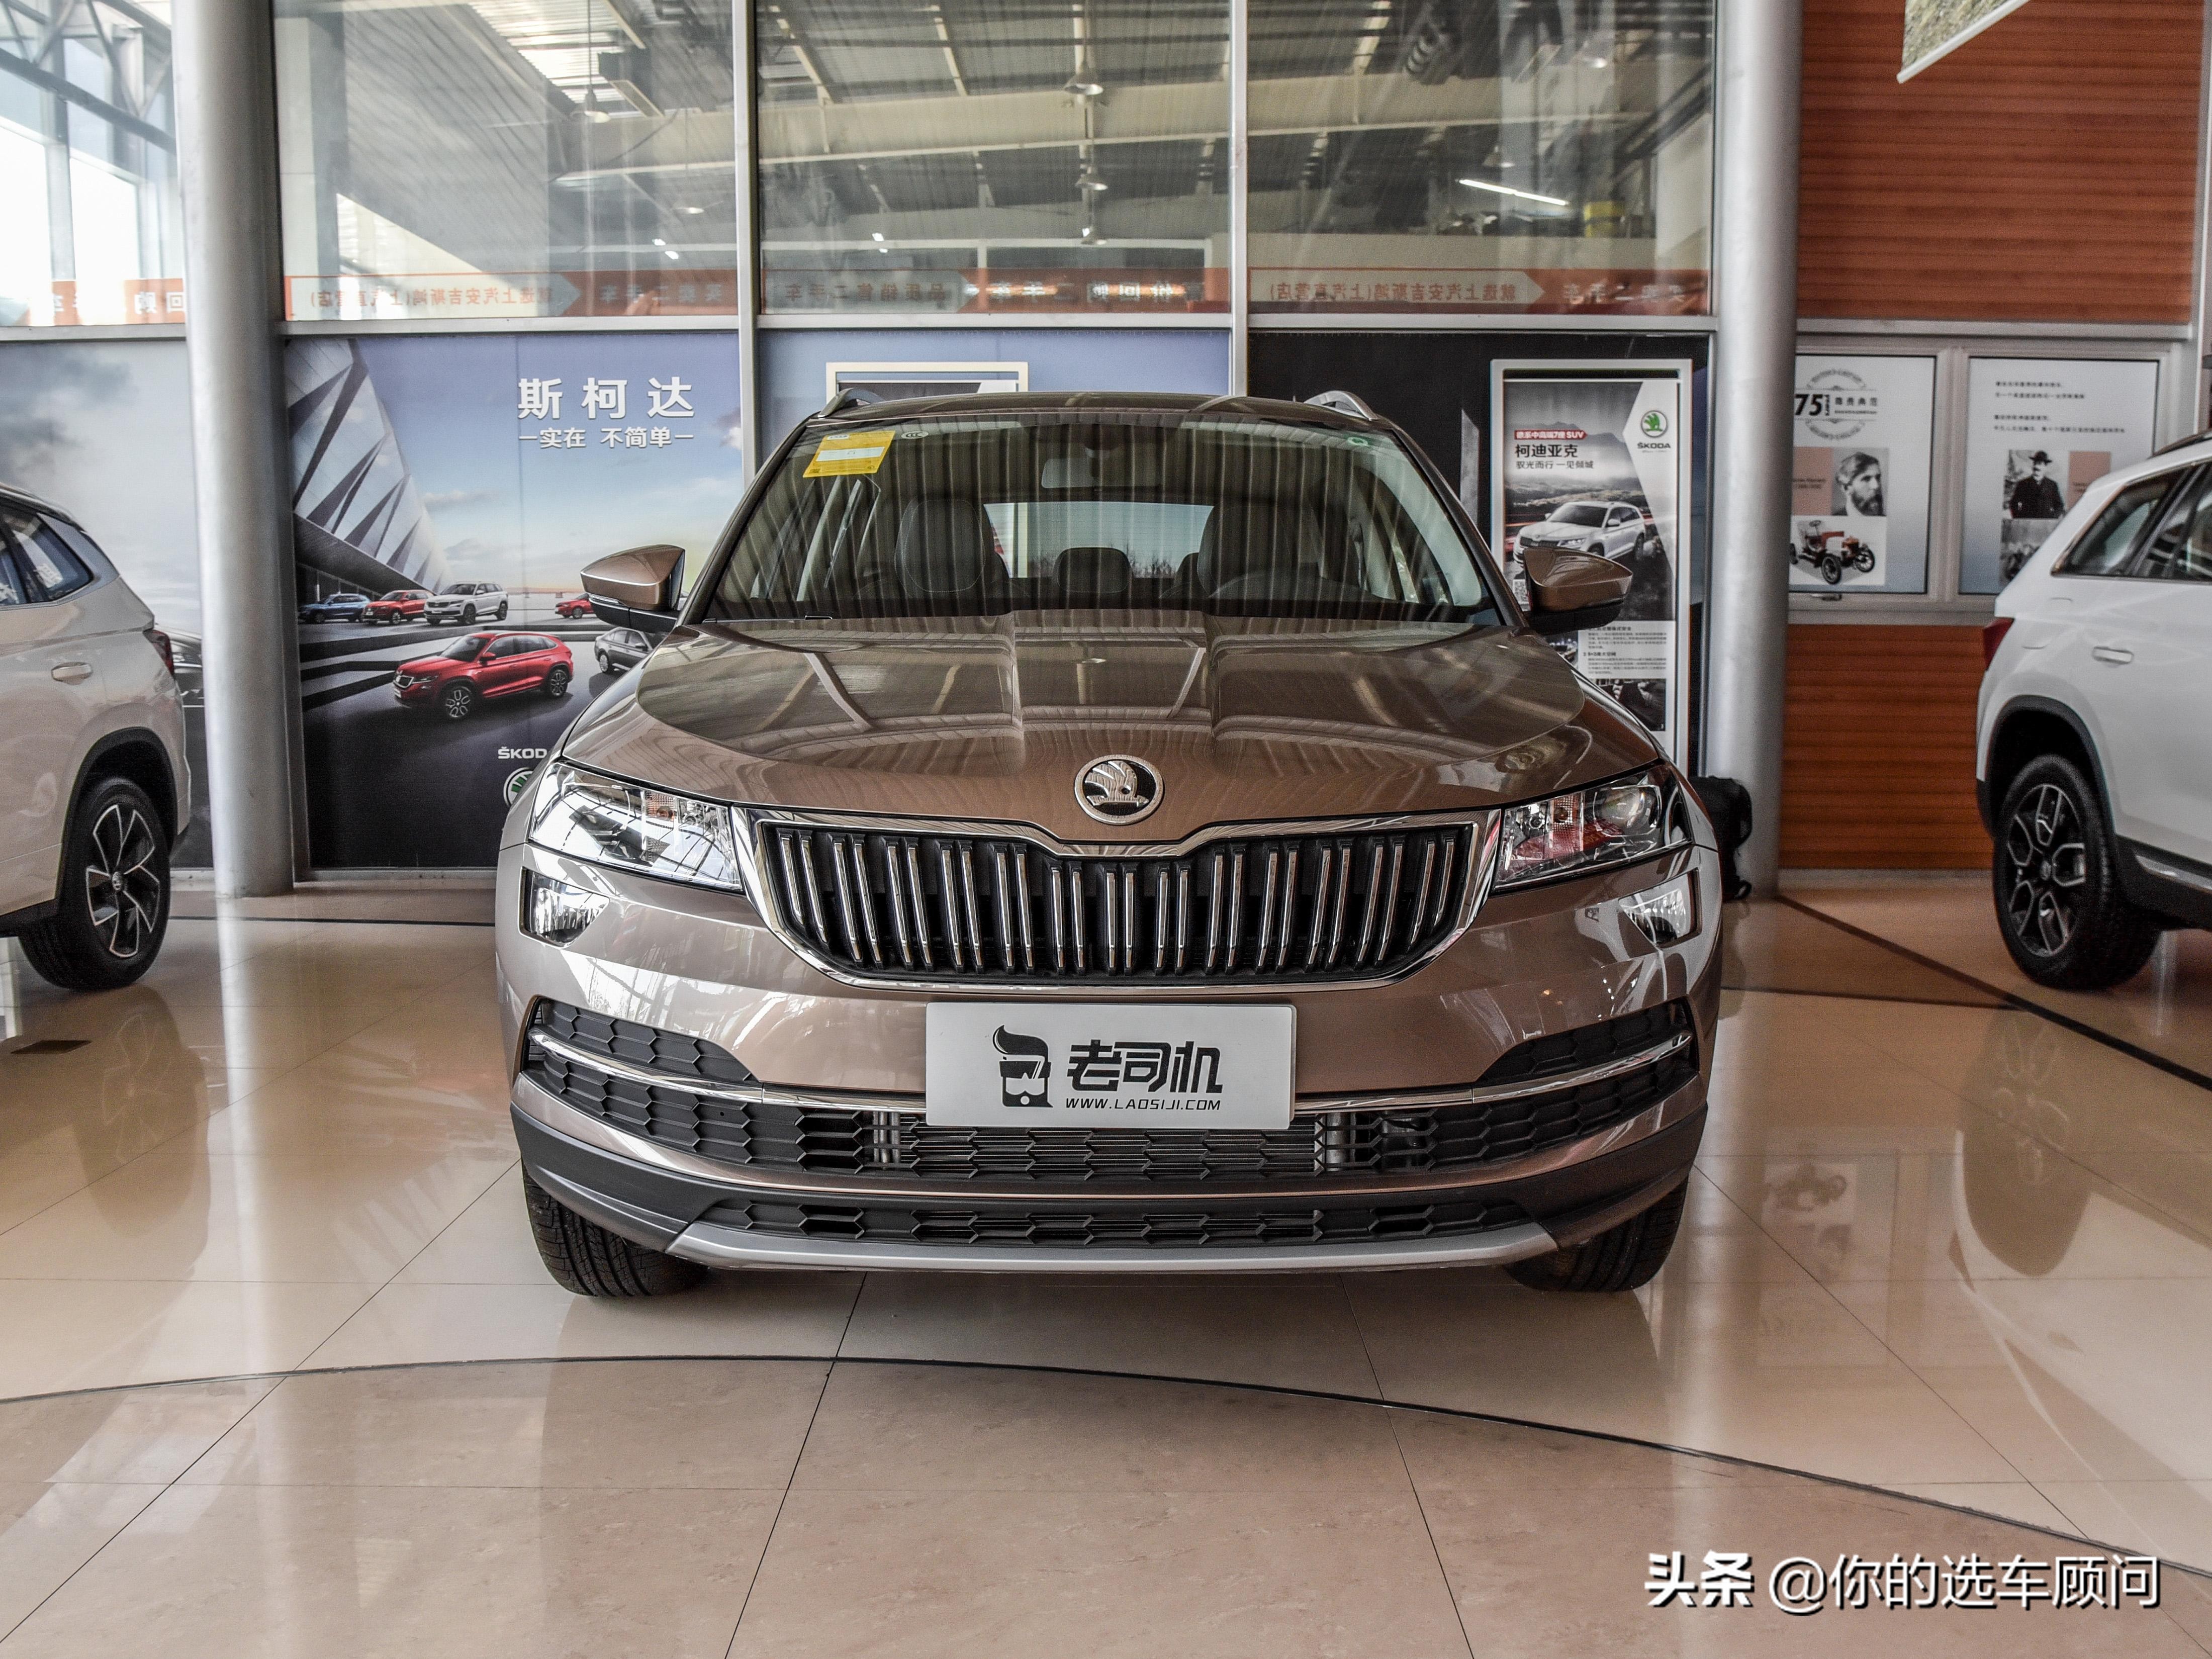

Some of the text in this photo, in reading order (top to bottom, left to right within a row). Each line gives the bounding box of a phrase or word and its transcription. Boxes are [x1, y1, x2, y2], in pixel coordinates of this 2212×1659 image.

[518, 377, 695, 419] 斯柯达
[1515, 443, 1579, 458] 柯迪亚克
[498, 746, 547, 760] ŠKOD
[1067, 1039, 1223, 1094] 老司机
[1066, 1097, 1221, 1111] WWW.LAOSIJI.COM
